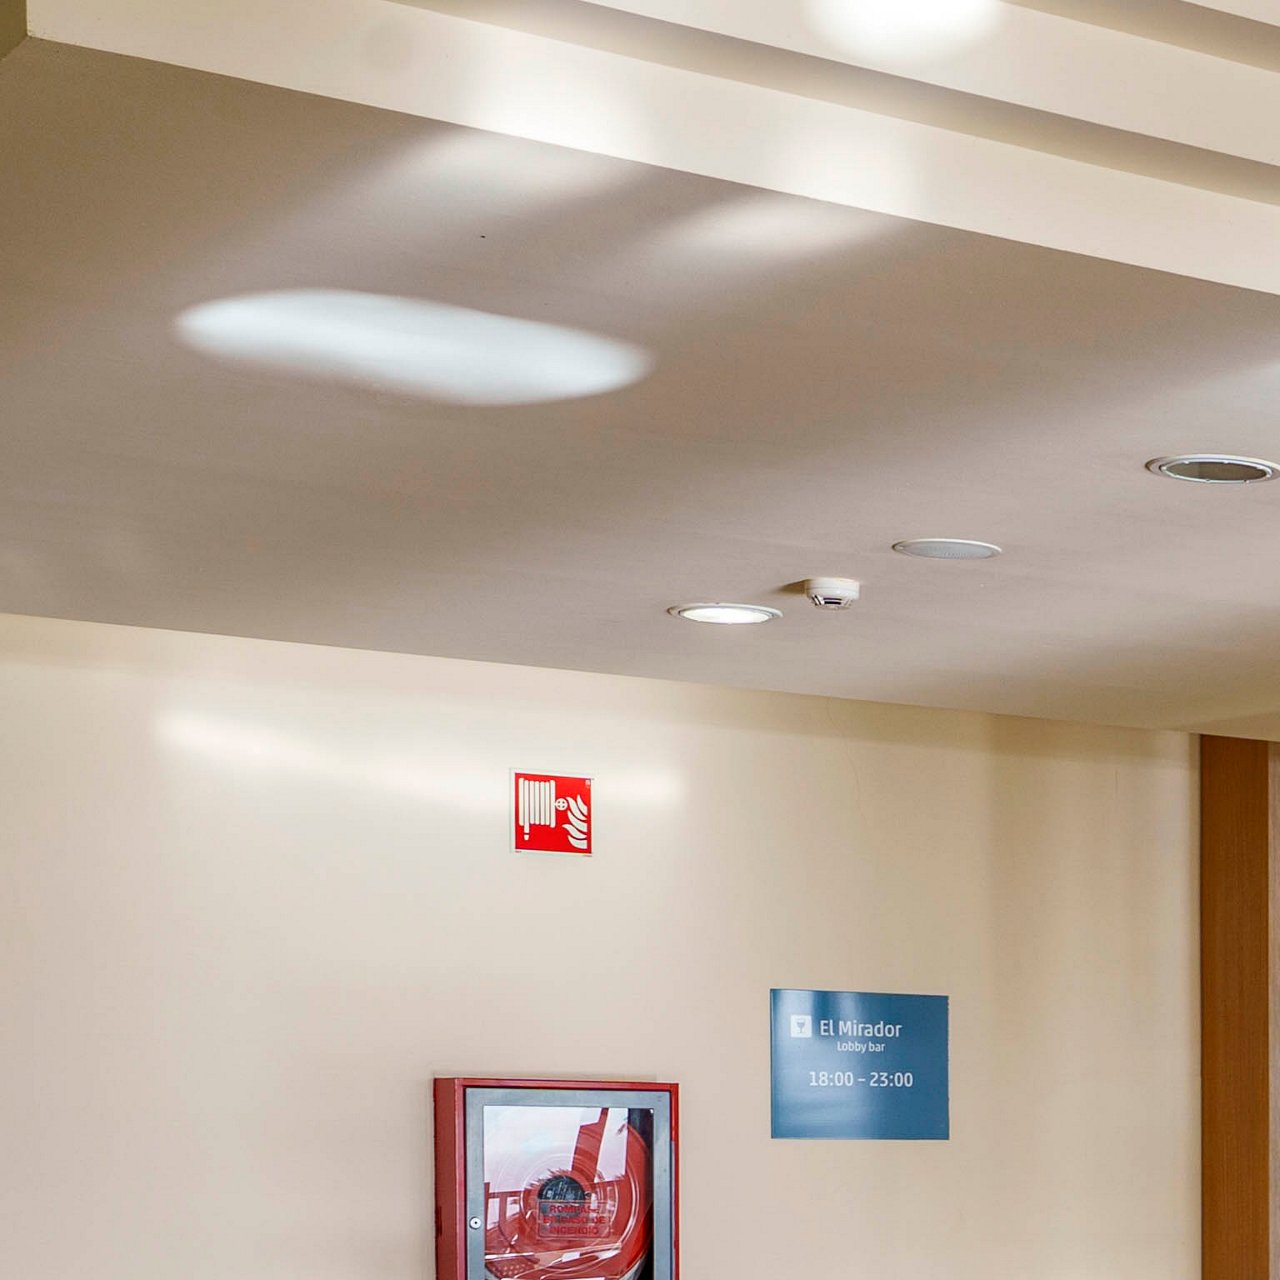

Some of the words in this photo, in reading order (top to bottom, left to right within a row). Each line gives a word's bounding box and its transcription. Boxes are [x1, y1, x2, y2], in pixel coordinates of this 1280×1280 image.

[820, 1020, 834, 1036] El
[839, 1020, 902, 1037] Mirador
[837, 1041, 867, 1053] Lobby
[869, 1042, 885, 1052] bar
[809, 1071, 854, 1087] 18:00
[870, 1072, 913, 1087] 23:00
